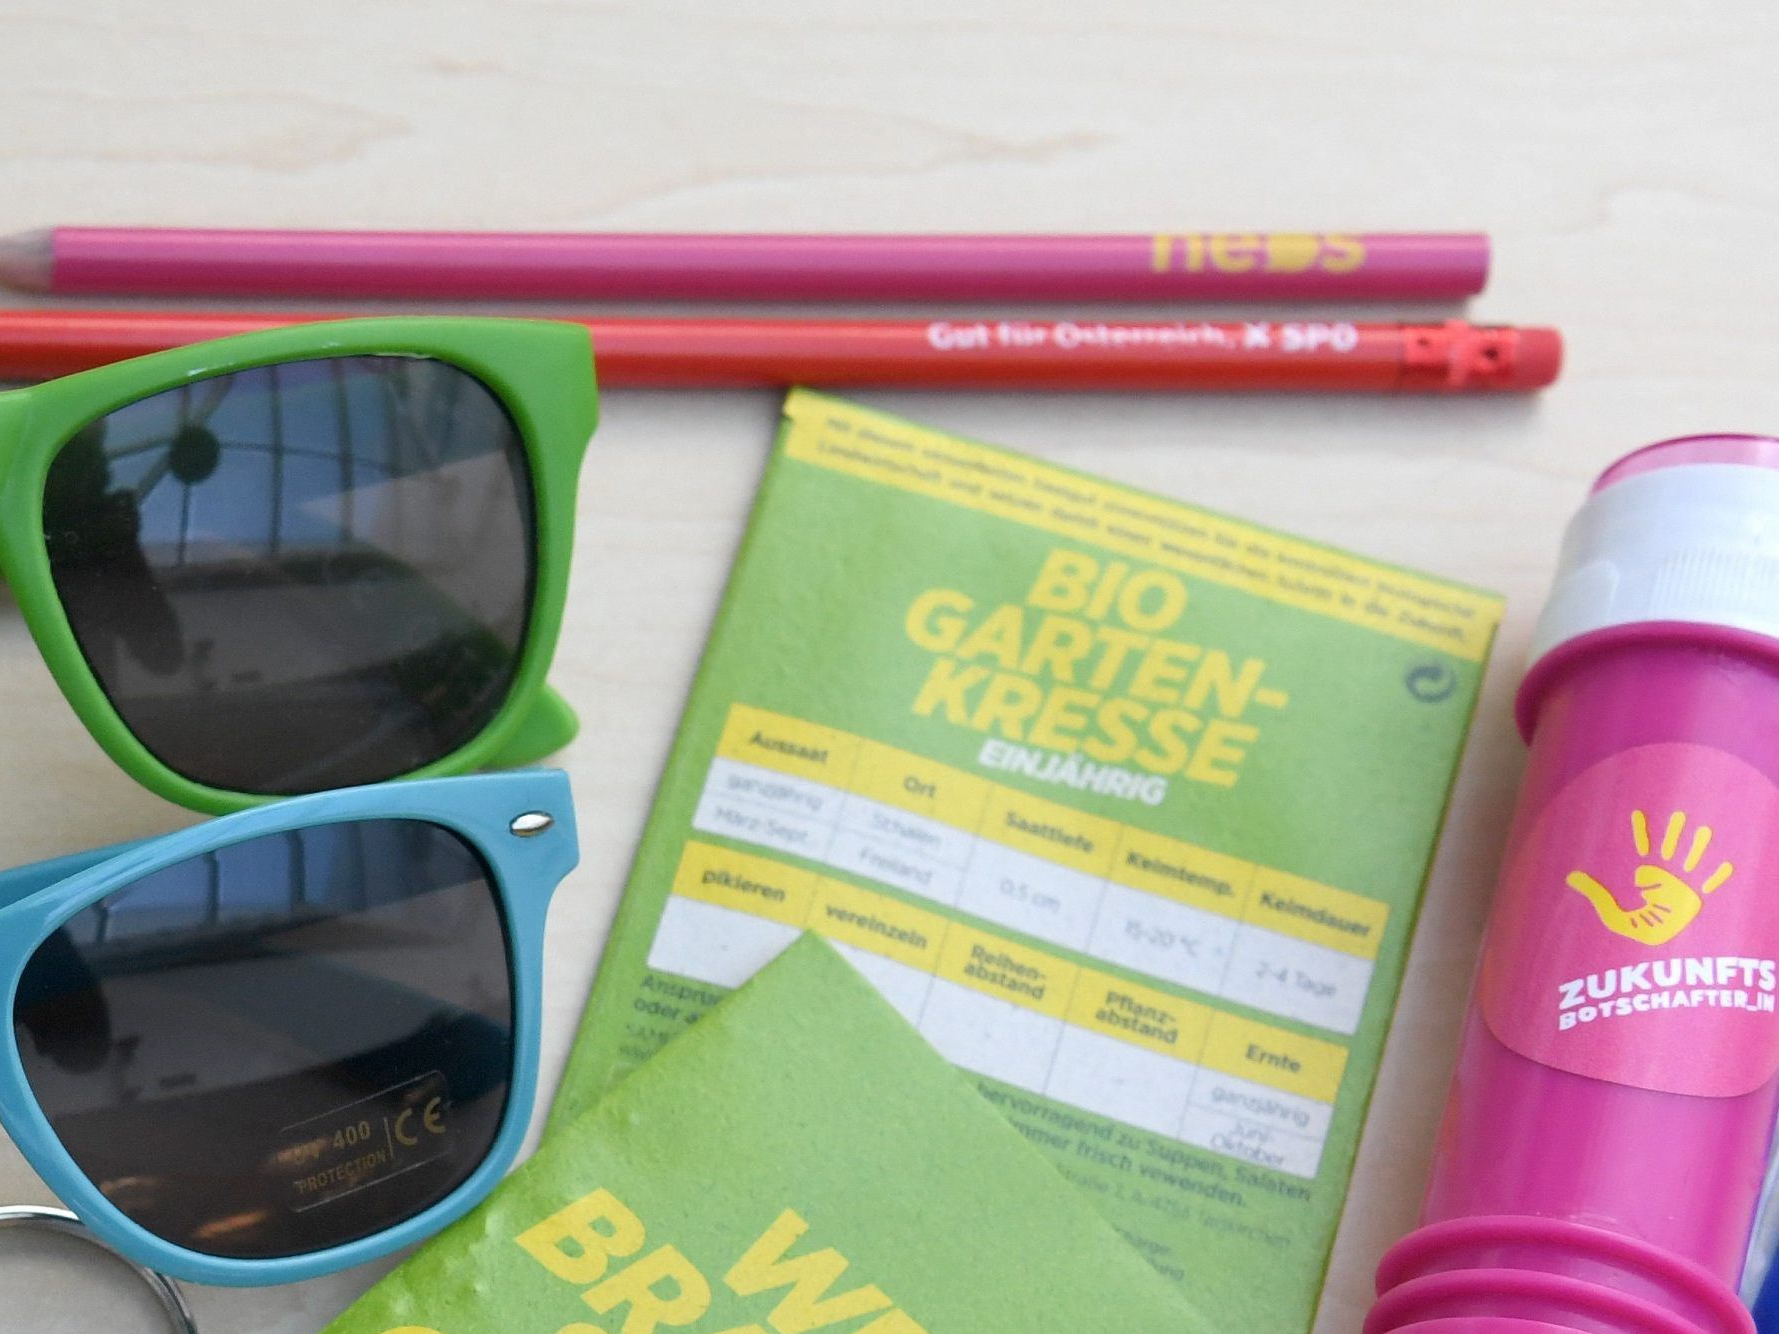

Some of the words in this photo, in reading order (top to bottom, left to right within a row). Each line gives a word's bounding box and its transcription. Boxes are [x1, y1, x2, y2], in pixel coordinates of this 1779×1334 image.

[927, 322, 989, 350] Gut
[1244, 322, 1271, 348] X
[1028, 547, 1187, 633] BIO
[905, 587, 1289, 719] GARTEN-
[912, 657, 1259, 789] KRESSE
[750, 731, 829, 764] Aussaat
[903, 775, 937, 800] Ort
[977, 737, 1167, 806] EINJÄHRIG
[1005, 810, 1095, 854] Saattiefe
[701, 866, 786, 902] pikieren
[1126, 851, 1235, 898] Keimtemp.
[826, 904, 928, 950] vereinzeln
[1259, 891, 1372, 937] Keimdauer
[964, 963, 1045, 1001] abstand
[971, 944, 1046, 980] Reihen-
[1559, 957, 1776, 1010] ZUKUNFTS
[1095, 1007, 1179, 1045] abstand
[1245, 1043, 1301, 1073] Ernte
[333, 1120, 371, 1150] 400
[394, 1097, 446, 1145] CE
[294, 1149, 388, 1194] PROTECTION
